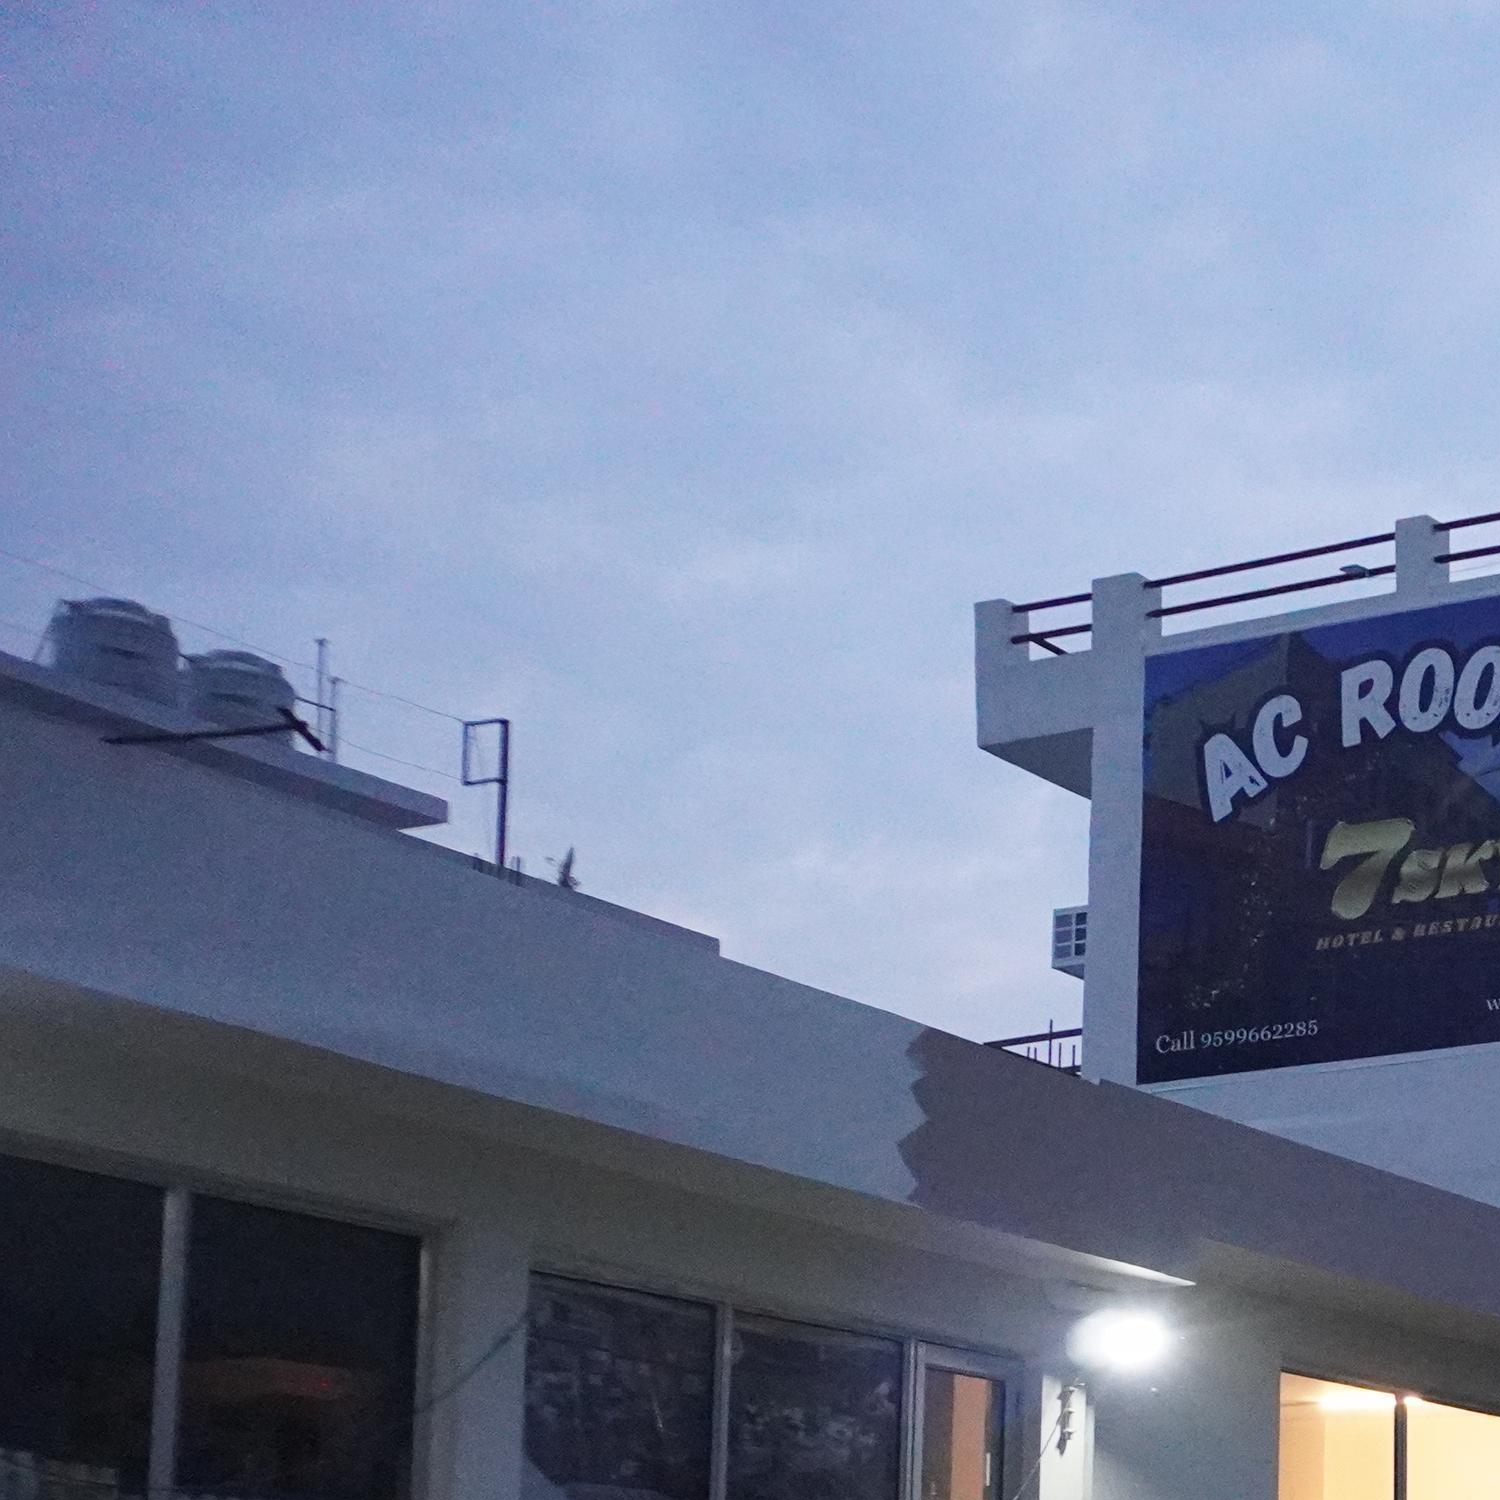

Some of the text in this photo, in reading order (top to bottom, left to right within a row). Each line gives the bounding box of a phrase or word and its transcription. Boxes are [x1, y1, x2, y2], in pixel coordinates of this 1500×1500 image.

[1204, 695, 1308, 822] AC
[1316, 929, 1383, 951] HOTEL
[1391, 928, 1407, 941] &
[1155, 1020, 1318, 1053] Call 9599662285
